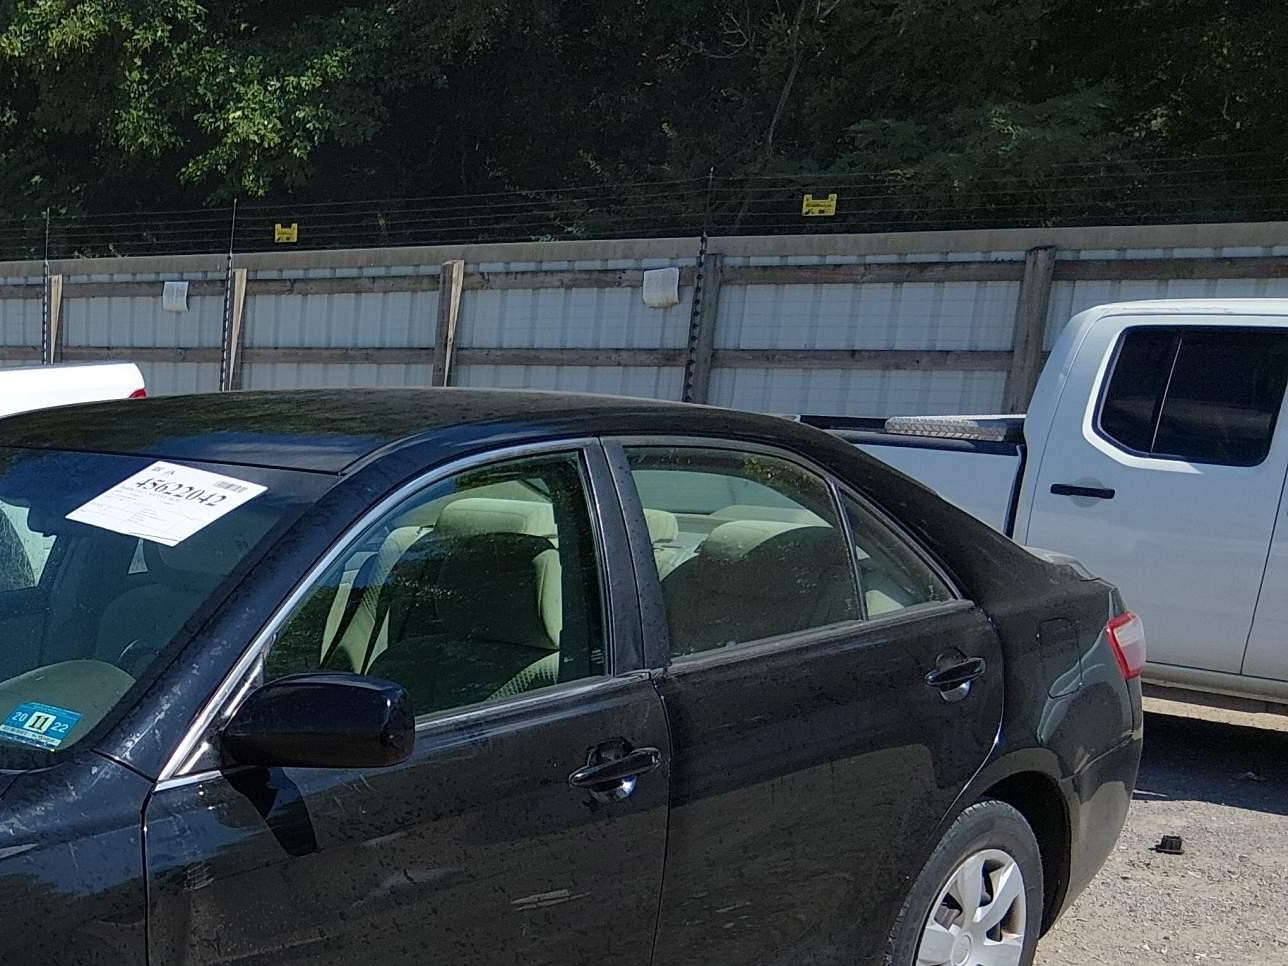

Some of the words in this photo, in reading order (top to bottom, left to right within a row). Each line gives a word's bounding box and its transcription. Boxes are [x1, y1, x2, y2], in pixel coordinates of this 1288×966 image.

[136, 478, 227, 506] 45622042
[12, 712, 28, 721] 20
[29, 715, 50, 731] 11
[51, 722, 69, 732] 22
